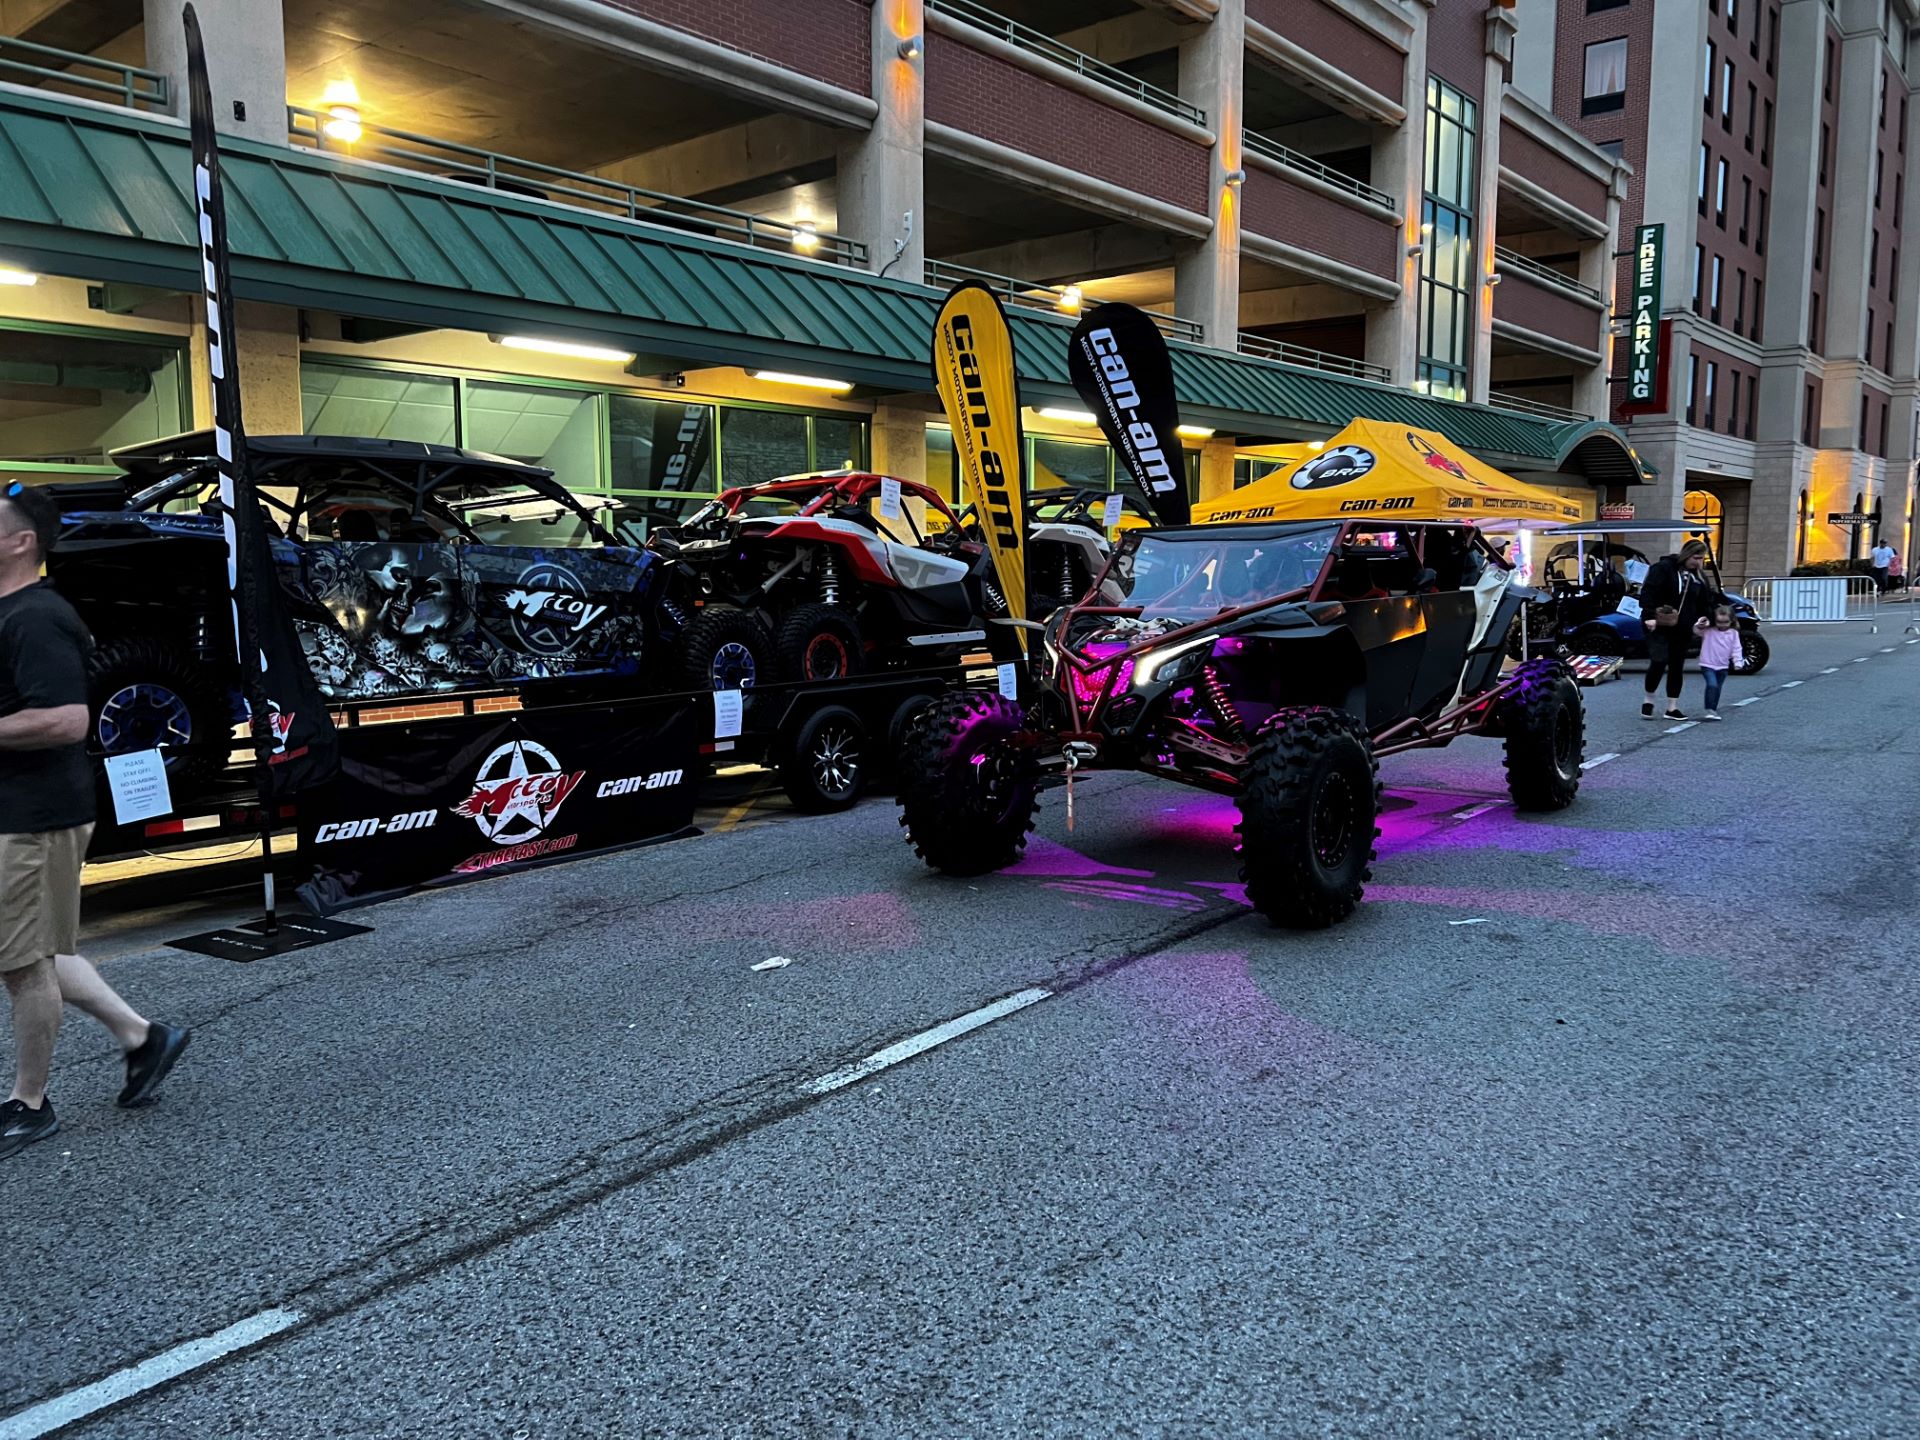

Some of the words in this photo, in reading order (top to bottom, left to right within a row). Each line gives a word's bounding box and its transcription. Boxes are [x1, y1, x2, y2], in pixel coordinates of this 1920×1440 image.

[1639, 228, 1656, 288] FREE
[1632, 295, 1652, 399] PARKING
[943, 322, 956, 364] MCCOY
[952, 366, 974, 455] MOTORSPORTS
[1079, 336, 1097, 367] MCCOY
[1093, 366, 1123, 430] MOTORSPORTS
[1089, 327, 1177, 493] can-am
[952, 314, 1019, 550] can-am
[1318, 466, 1368, 479] BRP
[1208, 506, 1276, 522] can-am
[1339, 496, 1415, 511] can-am
[122, 770, 137, 778] STAY
[124, 759, 145, 767] PLEASE
[596, 769, 683, 798] can-am
[315, 809, 438, 843] can-am
